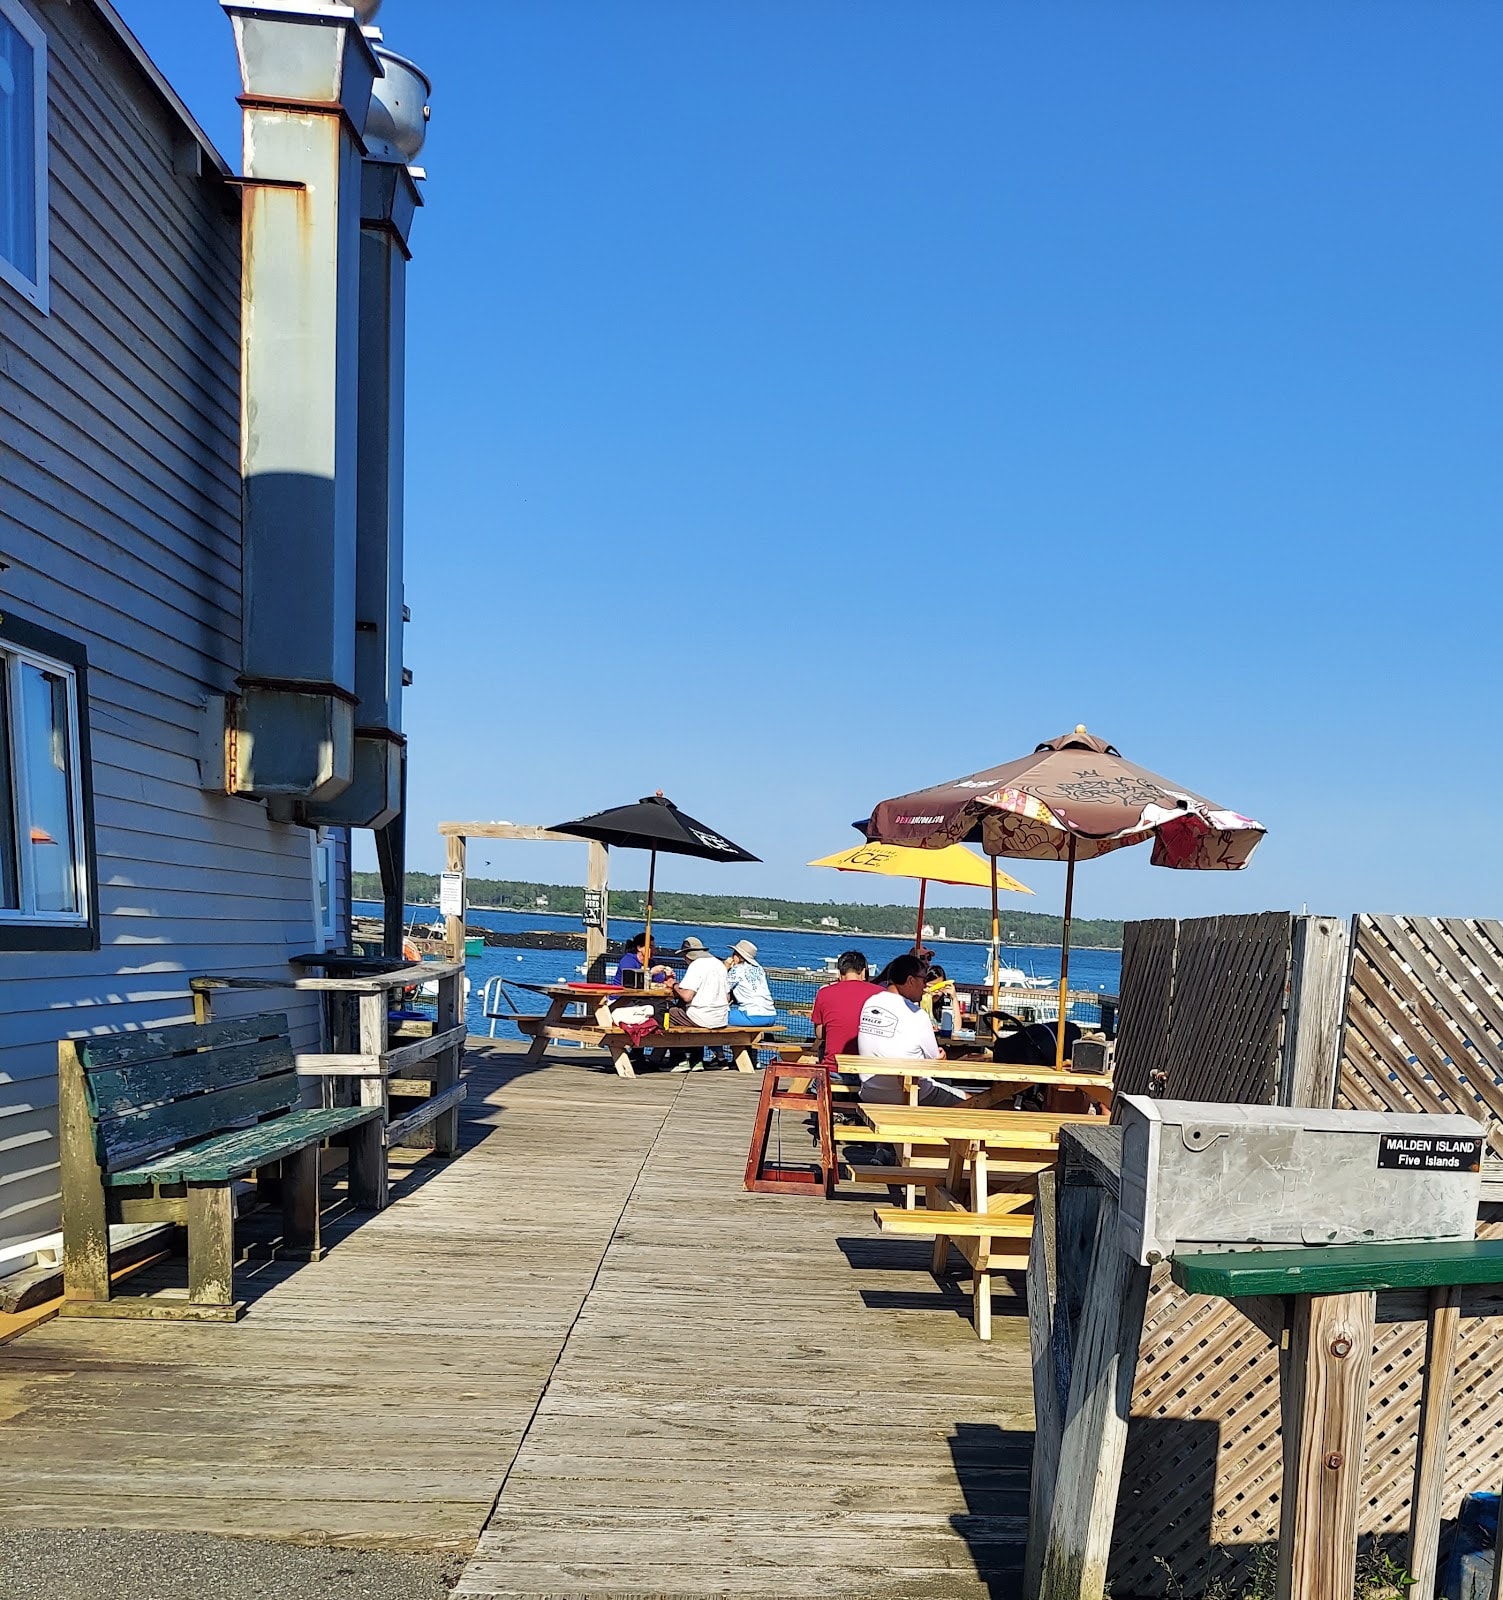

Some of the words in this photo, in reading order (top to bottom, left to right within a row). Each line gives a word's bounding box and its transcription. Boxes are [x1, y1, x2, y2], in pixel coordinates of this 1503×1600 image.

[843, 851, 889, 867] ICE
[1386, 1139, 1432, 1152] MALDEN
[1435, 1140, 1475, 1154] ISLAND
[1398, 1153, 1421, 1166] Five
[1425, 1155, 1460, 1168] Islands
